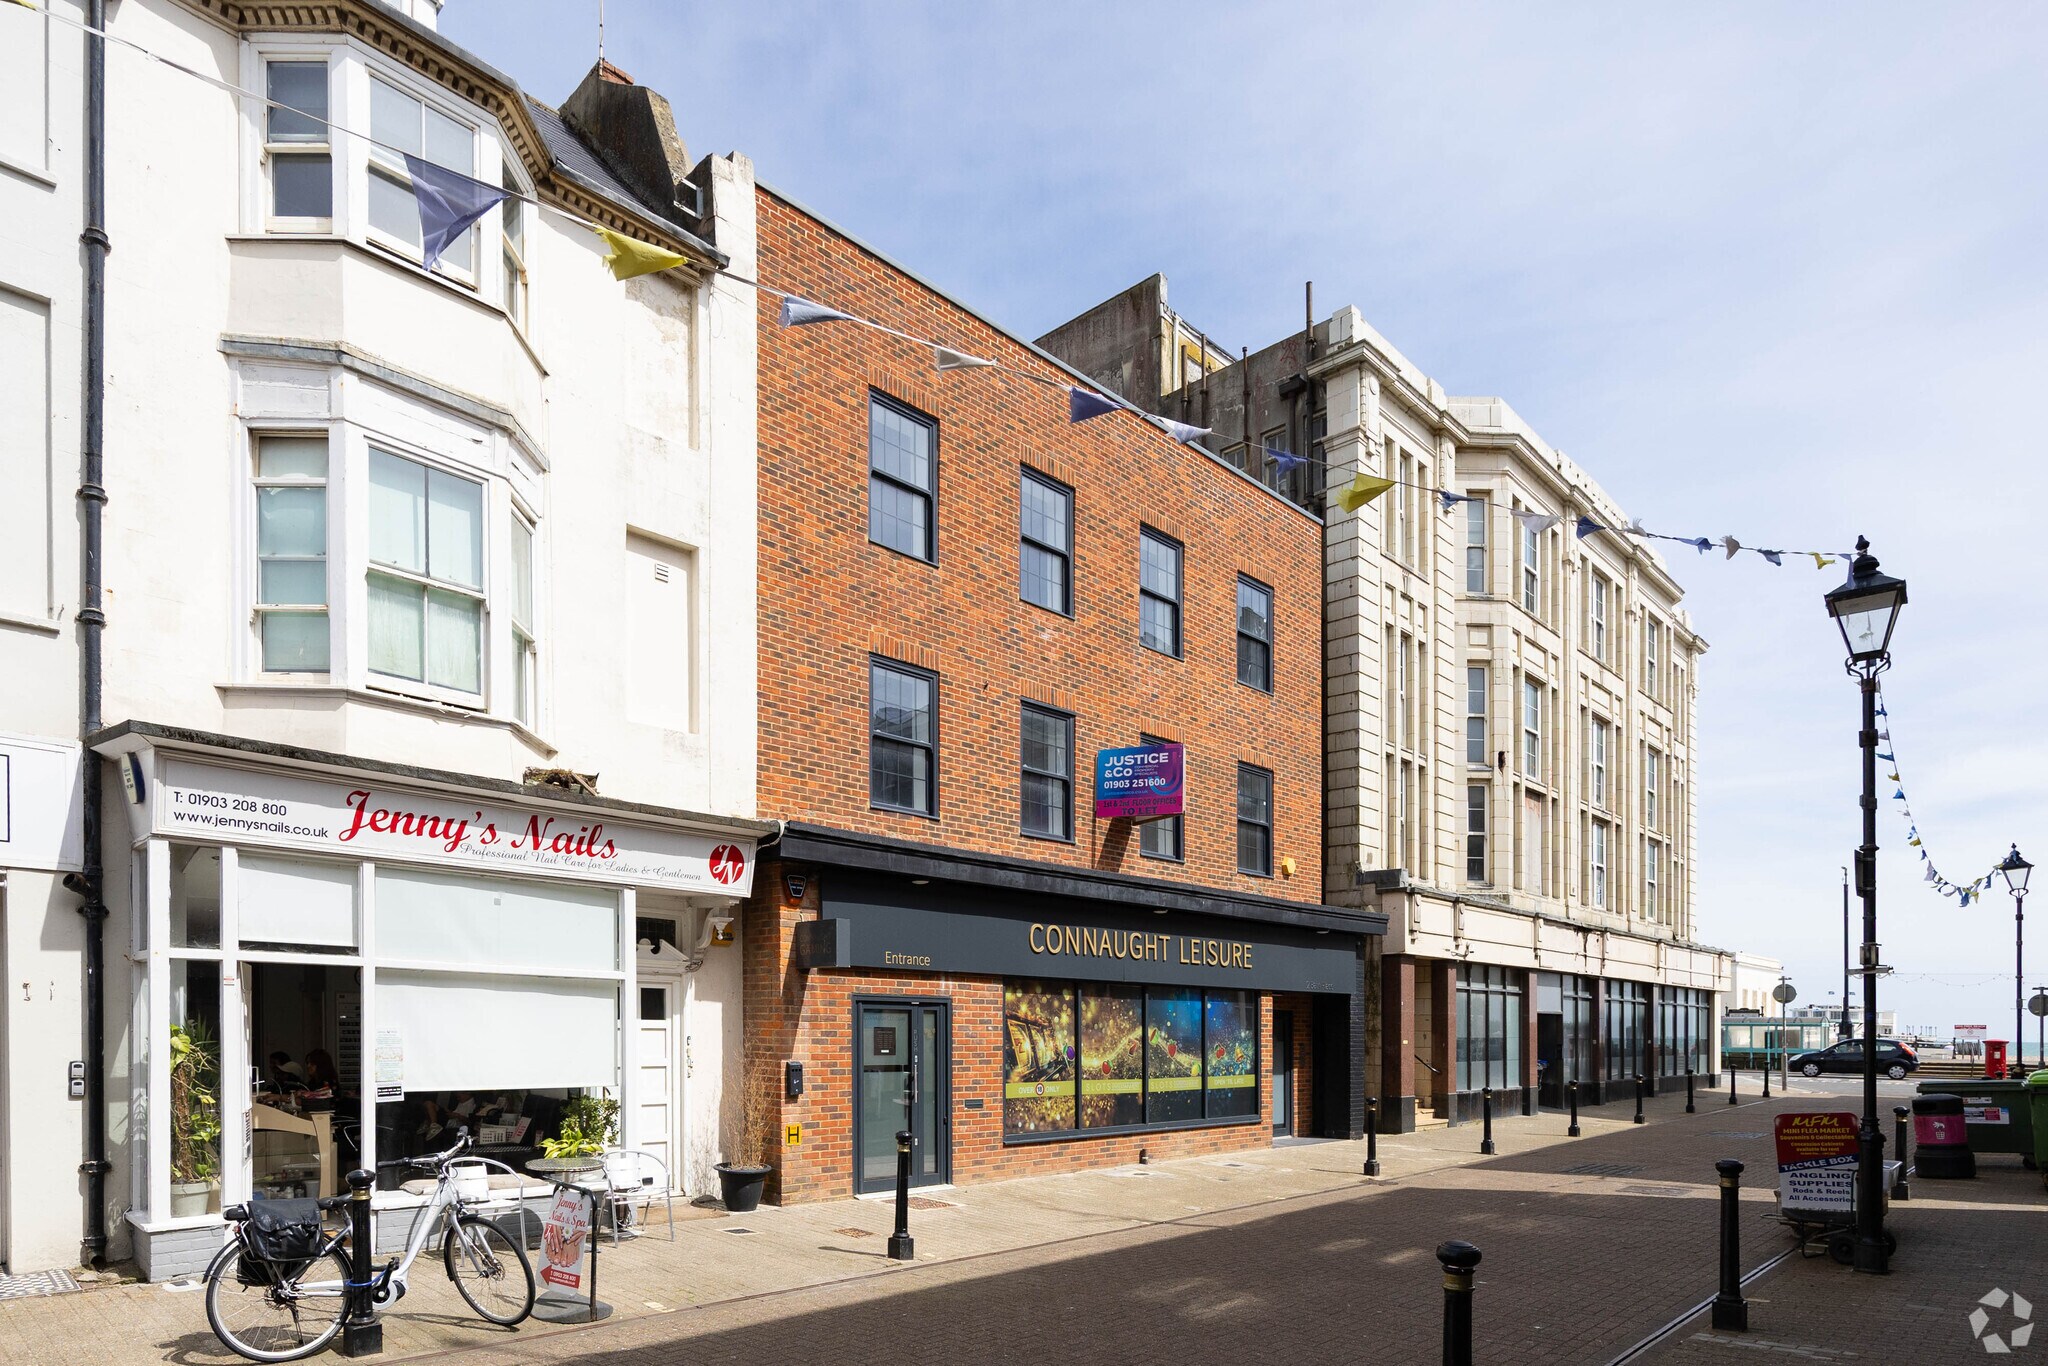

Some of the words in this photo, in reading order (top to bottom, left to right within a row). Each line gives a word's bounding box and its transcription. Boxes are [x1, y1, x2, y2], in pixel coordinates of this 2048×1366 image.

[1104, 752, 1169, 767] JUSTICE
[1104, 767, 1133, 778] &Co
[1103, 780, 1130, 789] 01903
[1132, 778, 1166, 788] 251600
[173, 791, 184, 804] T:
[188, 793, 228, 809] 01903
[232, 799, 258, 813] 208
[261, 803, 287, 816] 800
[1103, 800, 1112, 808] 1st
[1152, 797, 1177, 805] OFFICES
[1122, 807, 1136, 815] TO
[1138, 806, 1158, 815] LET
[173, 811, 329, 838] www.jennysnails.co.uk
[338, 790, 501, 853] Jenny's
[510, 814, 619, 859] Nails
[460, 842, 528, 861] Professional
[531, 851, 559, 864] Nail
[561, 855, 586, 868] Care
[587, 858, 602, 871] for
[604, 860, 638, 874] Ladies
[641, 866, 650, 874] &
[652, 867, 702, 881] Gentlemen
[1028, 922, 1171, 962] CONNAUGHT
[1178, 937, 1254, 969] LEISURE
[885, 951, 931, 967] Entrance
[1018, 1086, 1035, 1094] OVER
[1085, 1083, 1112, 1091] SLOTS
[787, 1126, 800, 1144] H
[1781, 1159, 1827, 1172] TACKLE
[1830, 1155, 1855, 1164] BOX
[555, 1194, 583, 1213] Jenny's
[571, 1214, 587, 1229] Spa
